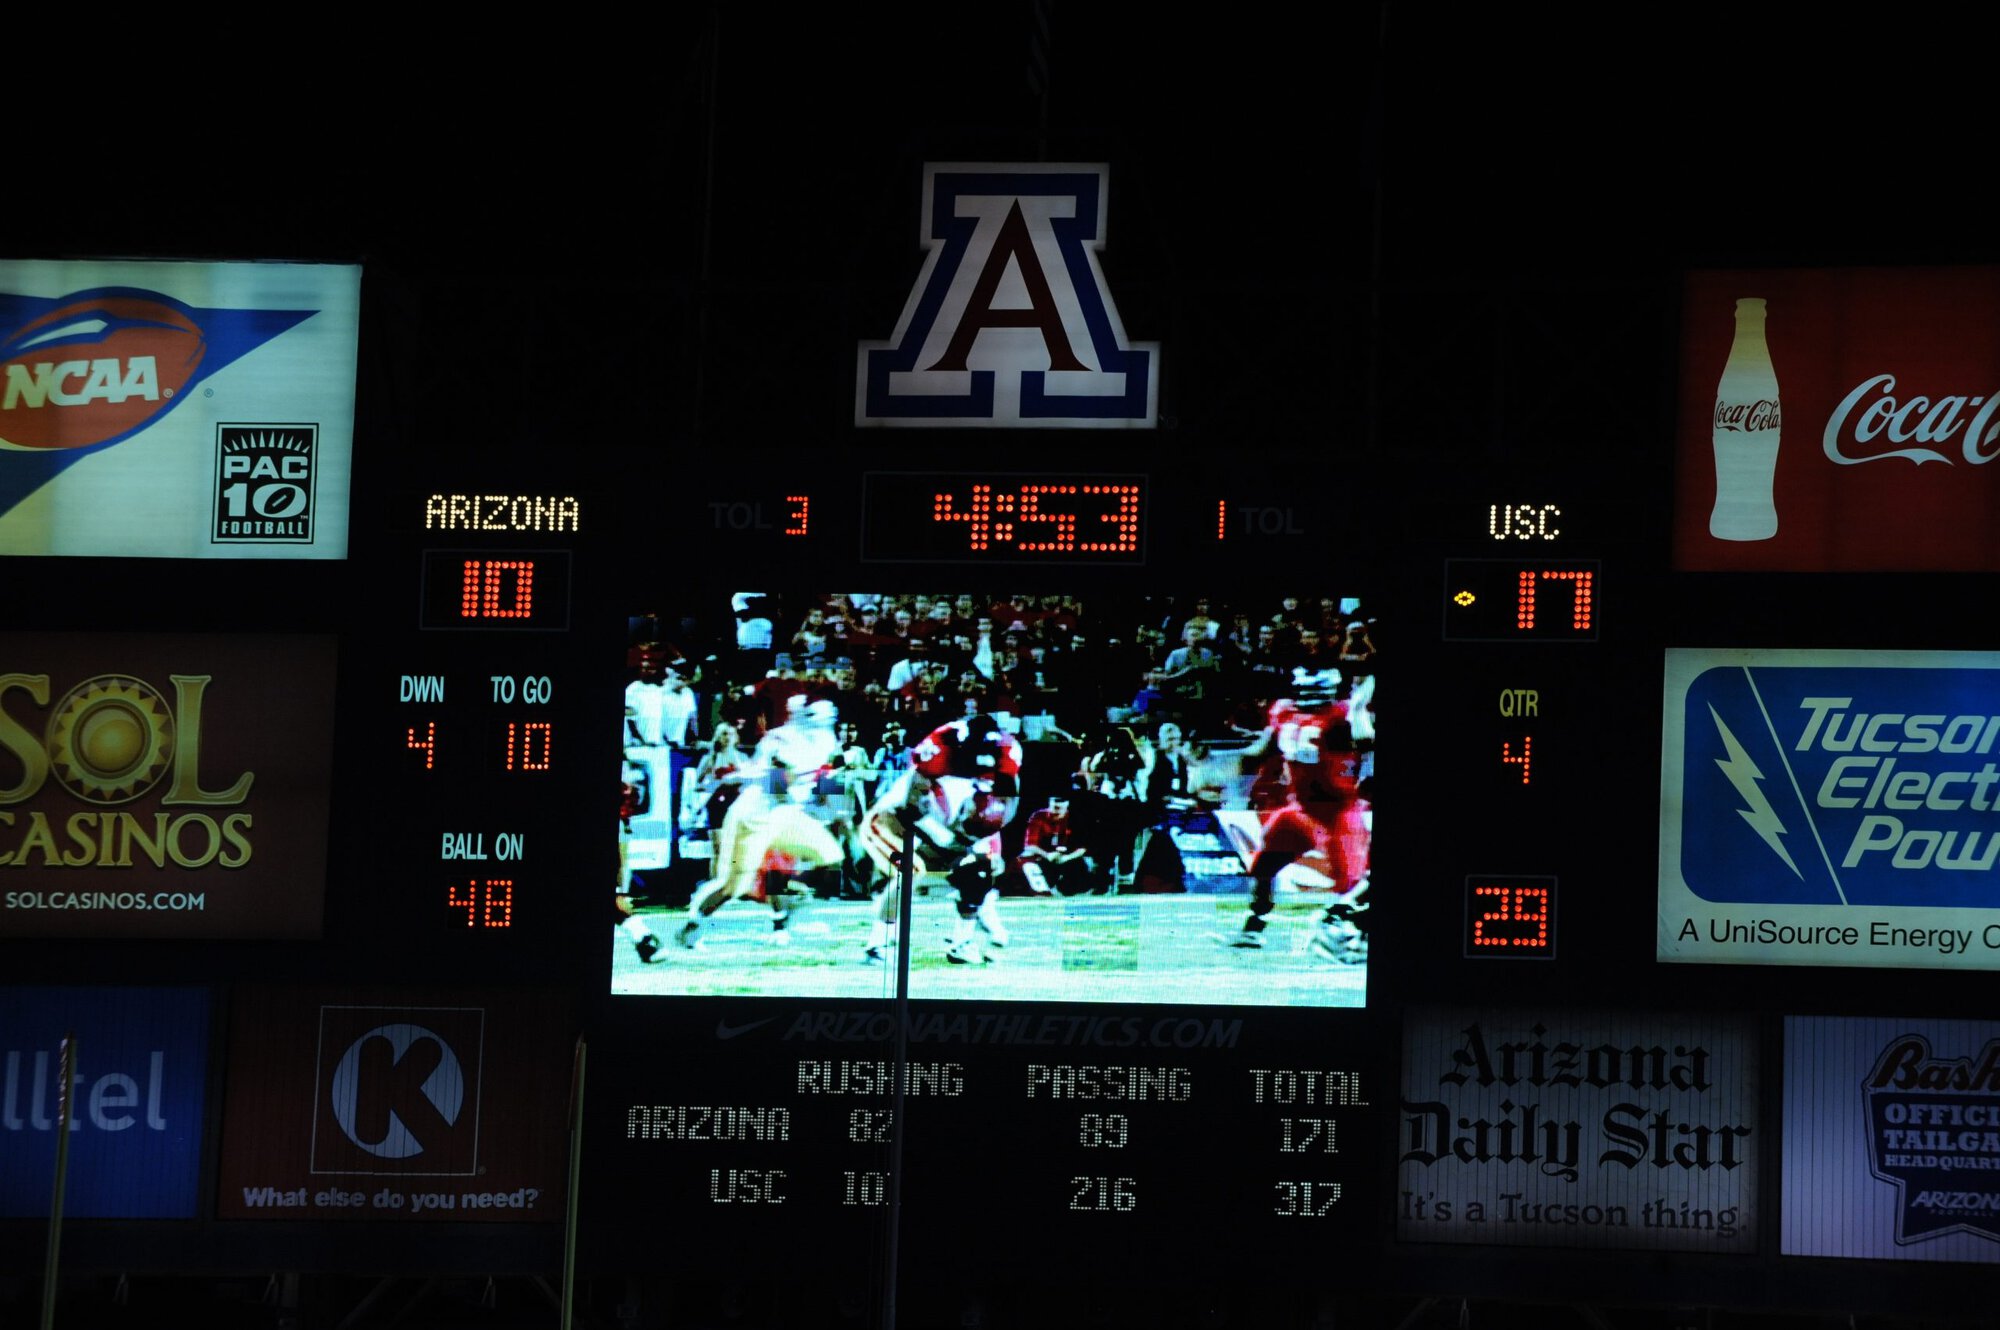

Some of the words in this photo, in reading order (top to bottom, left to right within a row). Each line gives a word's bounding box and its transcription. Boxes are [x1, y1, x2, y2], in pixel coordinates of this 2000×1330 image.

[854, 161, 1162, 428] A
[2, 356, 160, 410] NCAA
[1714, 399, 1780, 433] Coca-Cola
[223, 455, 309, 480] PAC
[223, 482, 308, 519] 10
[425, 494, 580, 532] ARIZONA
[708, 502, 773, 531] TOL
[785, 494, 809, 536] 3
[932, 483, 1139, 552] 4:53
[1217, 498, 1226, 541] 1
[1241, 505, 1304, 536] TOL
[221, 520, 304, 536] FOOTBALL
[1489, 504, 1561, 541] USC
[460, 560, 535, 618] 10
[1516, 569, 1593, 630] 17
[400, 674, 445, 703] DWN
[490, 675, 516, 704] TO
[522, 676, 553, 705] GO
[1499, 689, 1539, 718] QTR
[406, 721, 436, 771] 4
[505, 721, 552, 771] 10
[1502, 735, 1532, 785] 4
[1816, 755, 2000, 812] Elect
[441, 832, 488, 862] BALL
[495, 832, 526, 862] ON
[5, 890, 206, 912] SOLCASINOS.COM
[447, 877, 514, 928] 48
[1472, 885, 1549, 948] 29
[1678, 918, 1700, 942] A
[1710, 918, 1859, 945] UniSource
[1870, 922, 1973, 955] Energy
[782, 1010, 1244, 1049] ARIZONAATHLETICS.COM
[1439, 1022, 1712, 1093] Arizona
[797, 1060, 965, 1097] RUSHING
[1027, 1064, 1192, 1102] PASSING
[1248, 1069, 1370, 1106] TOTAL
[626, 1105, 791, 1143] ARIZONA
[848, 1108, 894, 1143] 82
[1079, 1113, 1129, 1148] 89
[1279, 1117, 1339, 1154] 171
[1400, 1096, 1580, 1183] Daily
[1600, 1103, 1753, 1171] Star
[242, 1186, 309, 1208] What
[315, 1187, 367, 1208] else
[373, 1188, 404, 1209] do
[411, 1191, 456, 1214] you
[462, 1186, 540, 1210] need?
[709, 1168, 789, 1204] USC
[842, 1171, 892, 1207] 10
[1069, 1175, 1137, 1211] 216
[1274, 1180, 1342, 1217] 317
[1400, 1191, 1453, 1223] It's
[1465, 1202, 1486, 1223] a
[1499, 1193, 1629, 1227] Tucson
[1642, 1198, 1748, 1239] thing.
